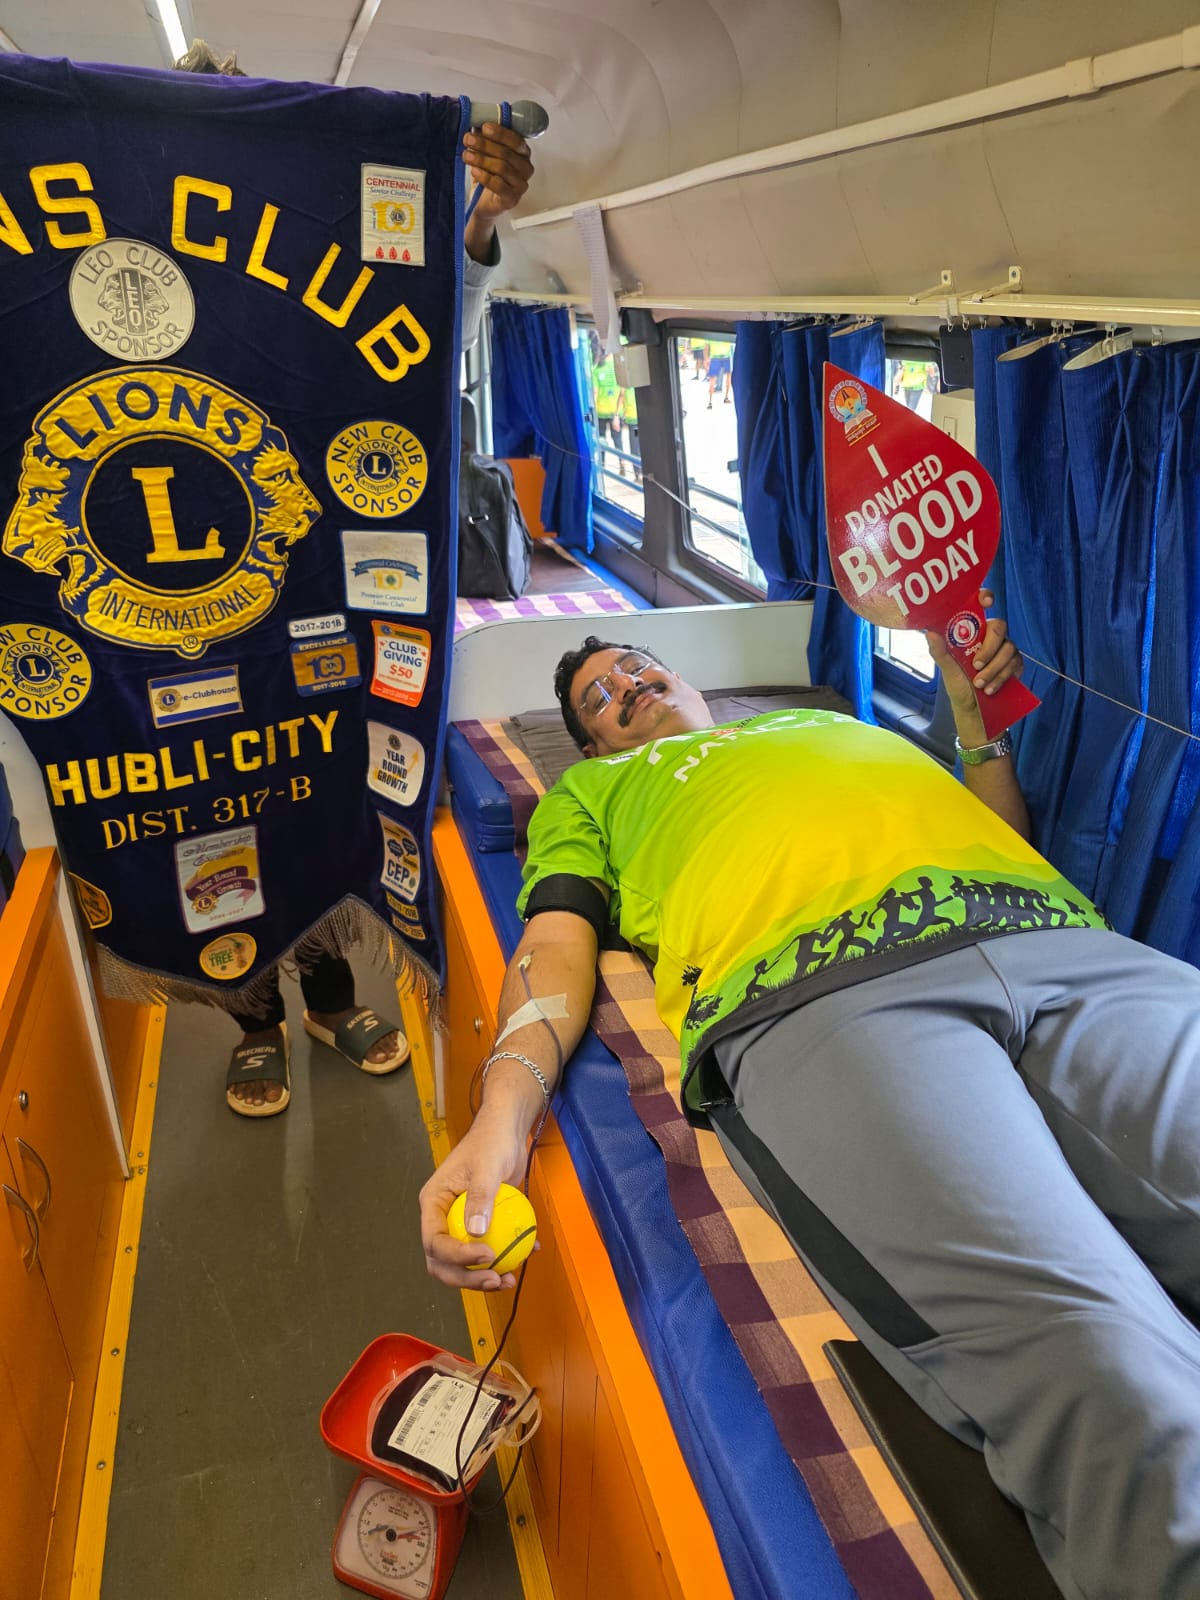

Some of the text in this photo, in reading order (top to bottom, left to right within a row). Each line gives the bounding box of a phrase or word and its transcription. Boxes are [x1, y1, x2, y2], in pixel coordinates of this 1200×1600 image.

[366, 177, 421, 191] CENTENNIAL
[78, 246, 178, 287] LEO CLUB
[171, 175, 431, 383] CLUB
[124, 272, 142, 326] LEO
[90, 320, 184, 356] SPONSOR
[54, 381, 250, 449] LIONS
[331, 425, 422, 465] NEW CLUB
[360, 441, 396, 453] LIONS
[371, 455, 387, 475] L
[867, 443, 889, 479] I
[334, 473, 422, 513] SPONSOR
[844, 454, 944, 539] DONATED
[131, 466, 226, 563] L
[838, 469, 983, 598] BLOOD
[887, 529, 980, 617] TODAY
[100, 583, 261, 630] INTERNATIONAL
[294, 619, 342, 632] 2017-2018
[10, 644, 50, 656] LIONS
[26, 627, 82, 664] CLUB
[383, 650, 422, 667] GIVING
[388, 641, 418, 655] CLUB
[25, 658, 47, 677] L
[306, 653, 346, 680] 100
[390, 663, 413, 679] $50
[184, 685, 237, 701] e-Clubhouse
[45, 710, 339, 807] HUBLI-CITY
[382, 758, 408, 780] ROUND
[386, 749, 406, 766] YEAR
[377, 769, 409, 794] GROWTH
[101, 775, 312, 849] DIST. 317-B
[387, 859, 410, 883] CEP
[209, 951, 234, 967] TREE
